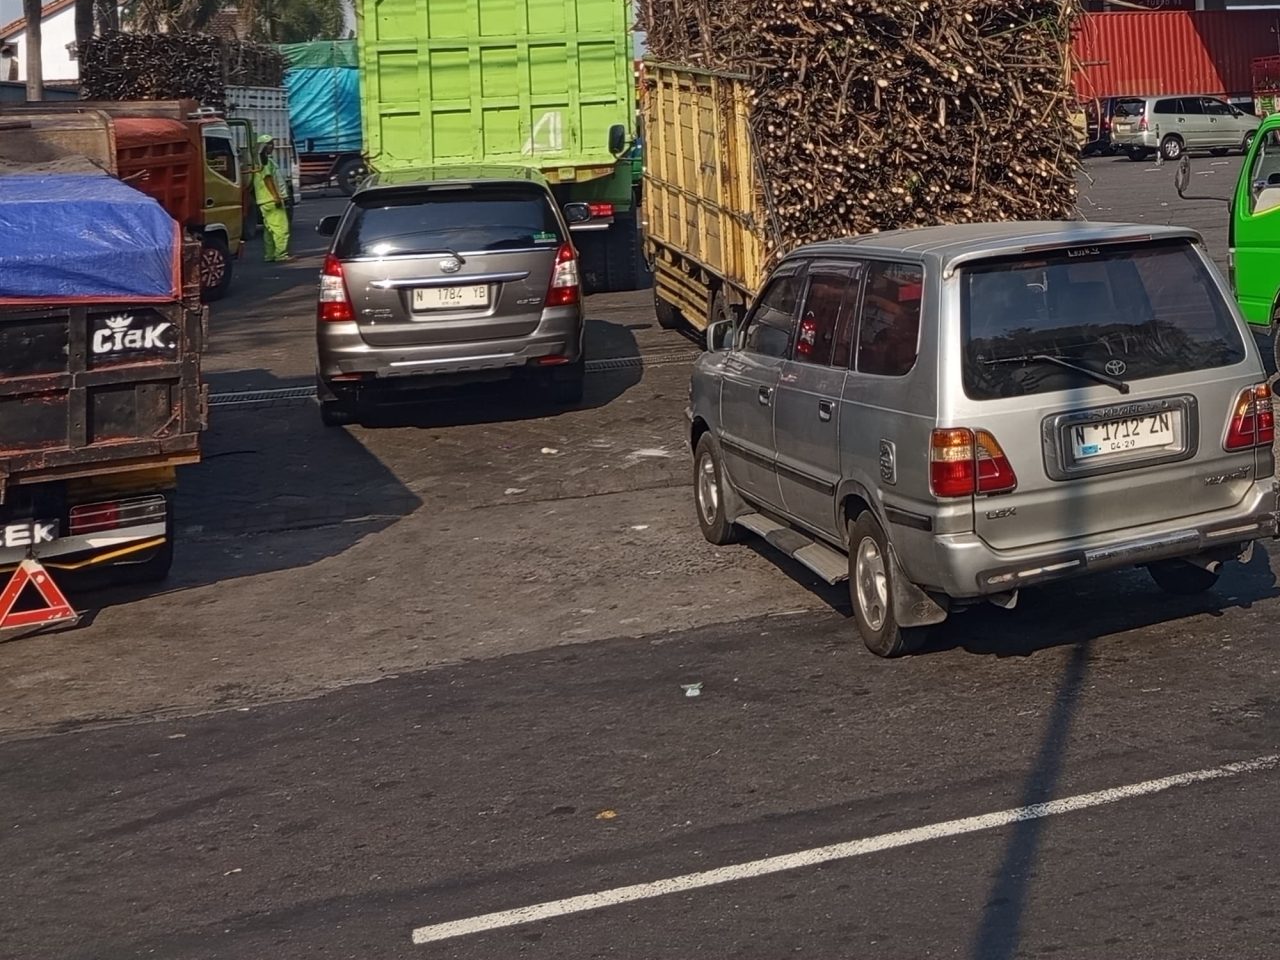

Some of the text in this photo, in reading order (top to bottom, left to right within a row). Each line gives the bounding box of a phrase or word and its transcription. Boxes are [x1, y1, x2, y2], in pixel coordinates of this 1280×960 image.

[416, 286, 486, 302] N 1784 YB
[1075, 413, 1170, 446] N 1712 ZN
[0, 523, 55, 548] EK
